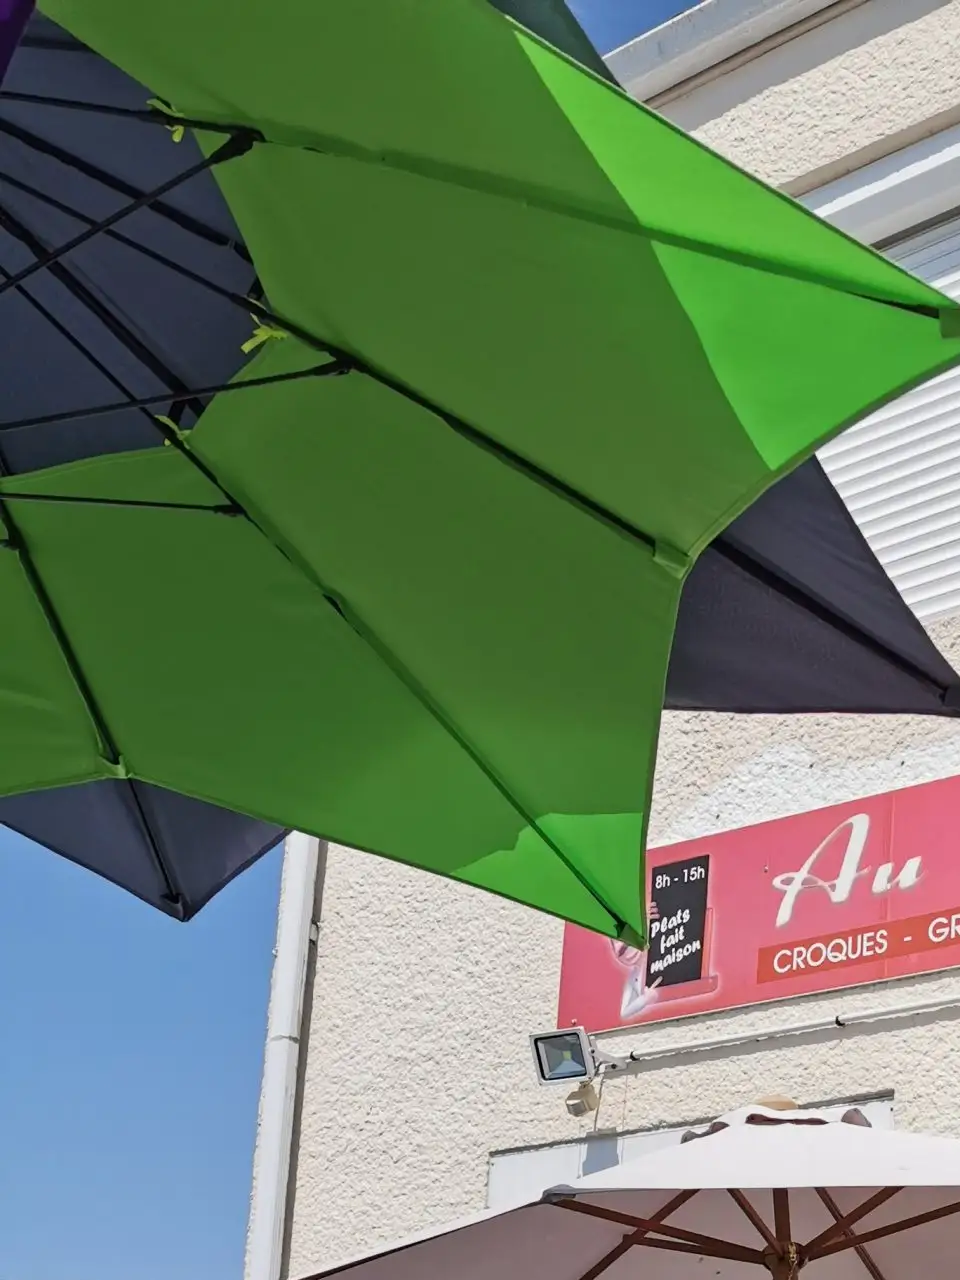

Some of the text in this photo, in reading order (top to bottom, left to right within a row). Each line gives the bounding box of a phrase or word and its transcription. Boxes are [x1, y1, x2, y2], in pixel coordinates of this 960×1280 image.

[655, 873, 670, 889] 8h
[683, 865, 705, 883] 15h
[772, 813, 925, 928] Au
[651, 908, 691, 938] Plats
[660, 925, 685, 954] fait
[773, 929, 888, 974] CROQUES
[650, 939, 701, 974] maison
